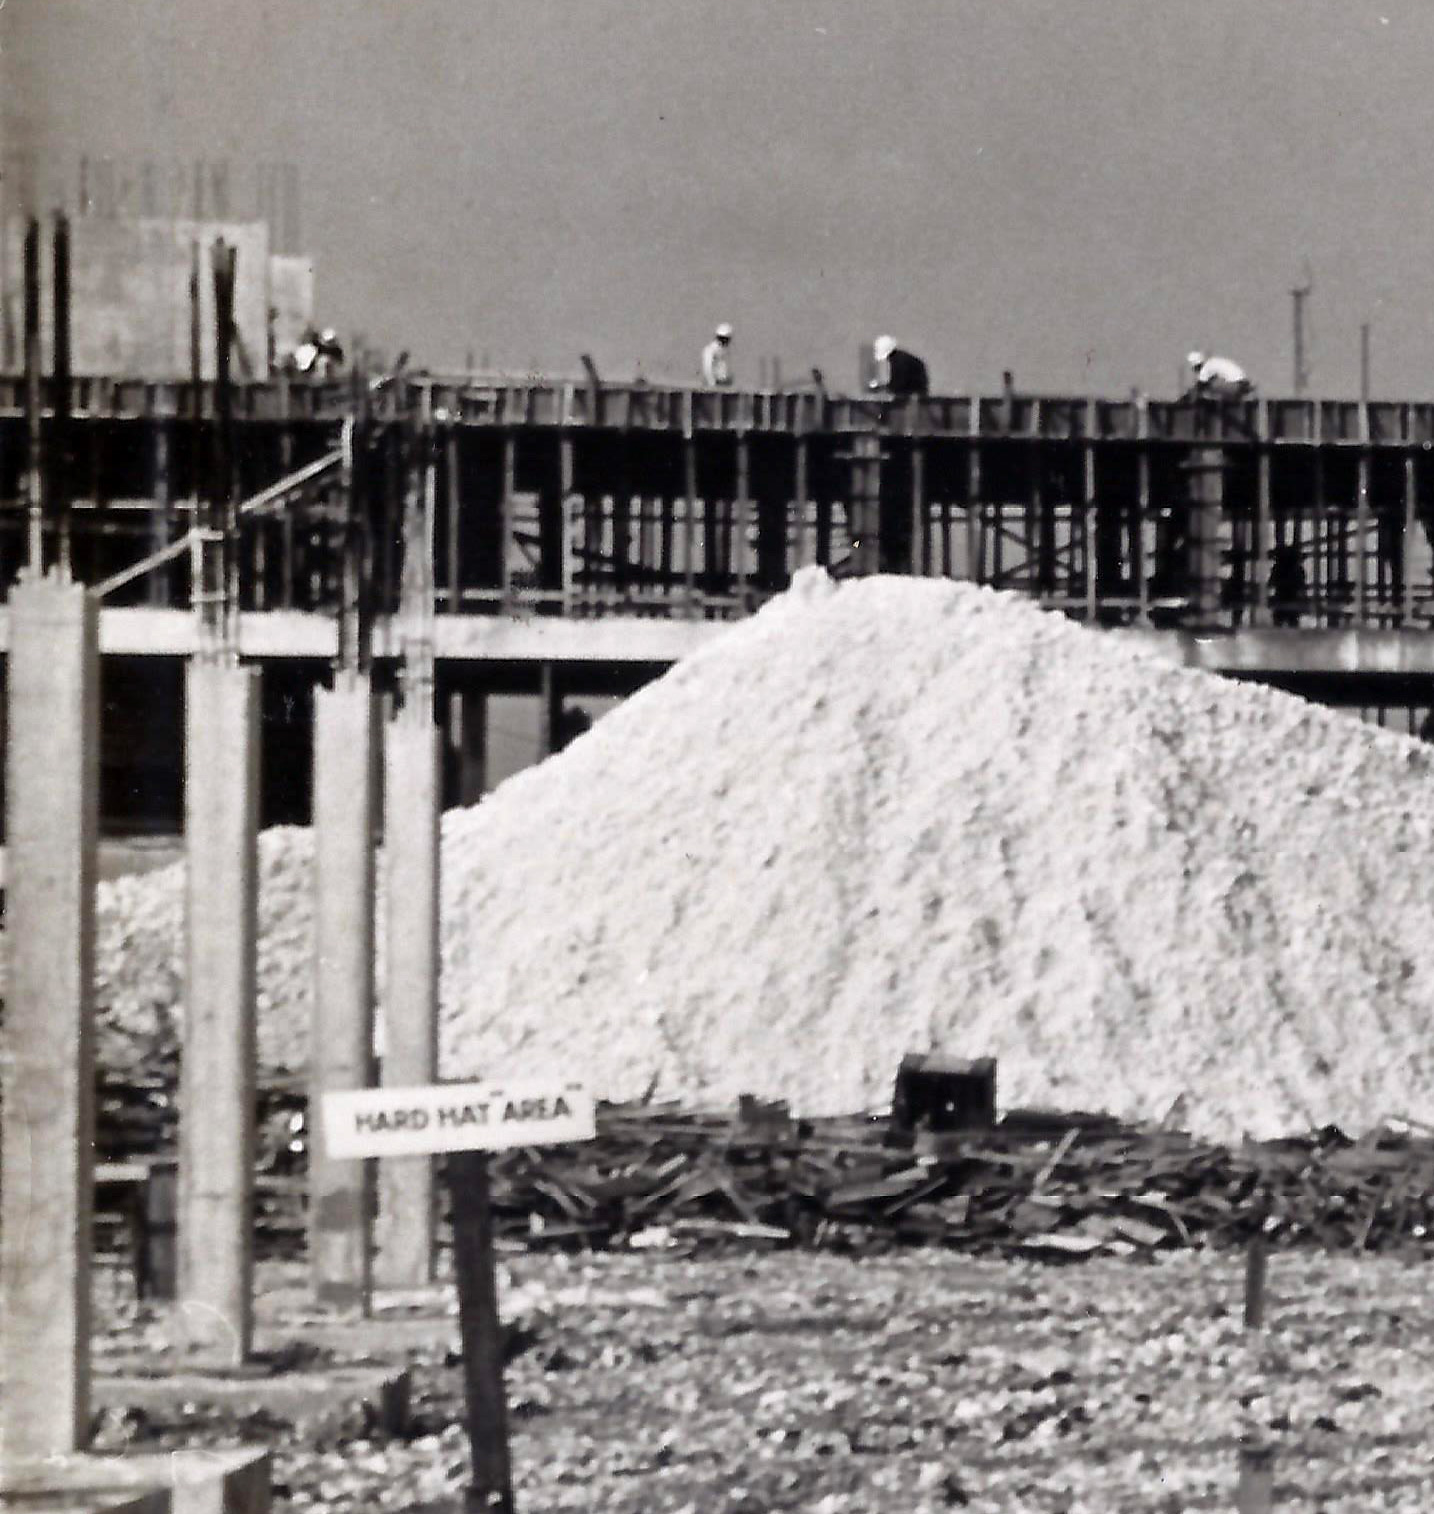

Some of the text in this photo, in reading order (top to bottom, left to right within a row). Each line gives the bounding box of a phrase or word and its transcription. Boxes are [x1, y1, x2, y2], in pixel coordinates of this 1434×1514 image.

[355, 1096, 572, 1133] HARD HAT AREA
